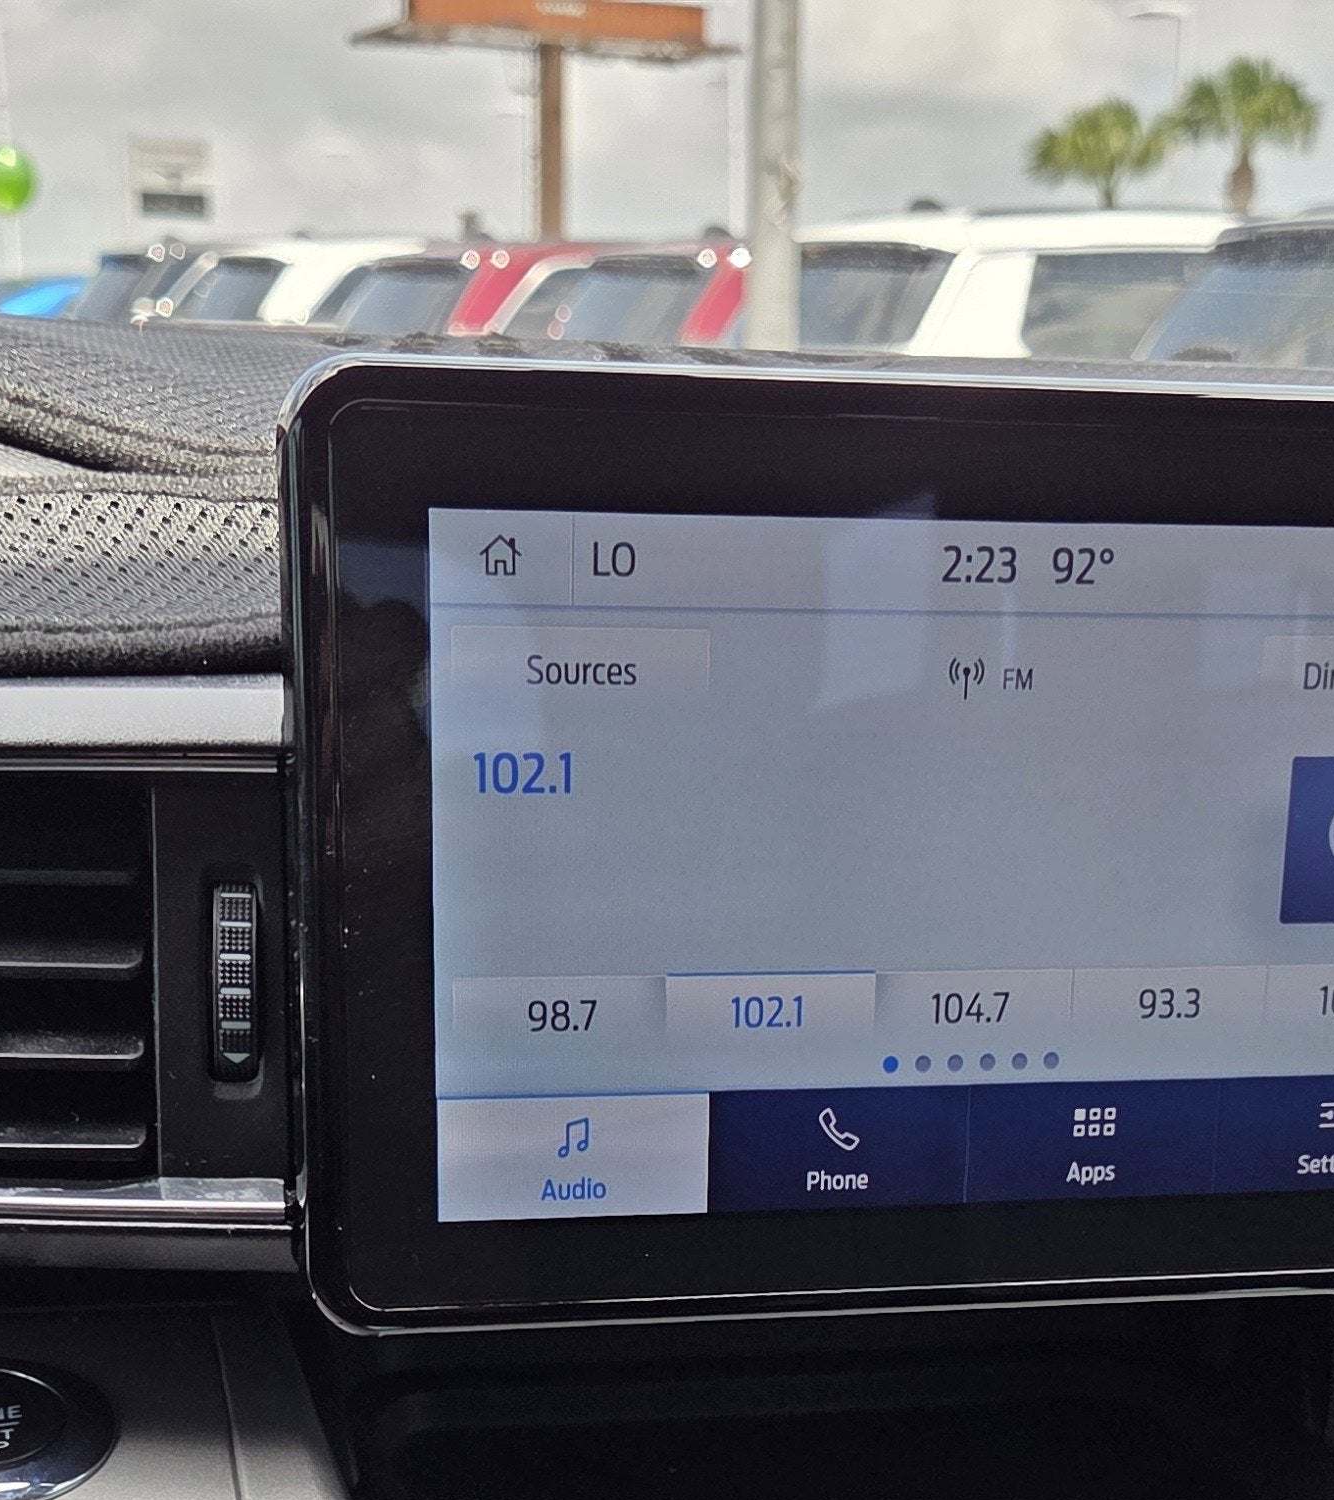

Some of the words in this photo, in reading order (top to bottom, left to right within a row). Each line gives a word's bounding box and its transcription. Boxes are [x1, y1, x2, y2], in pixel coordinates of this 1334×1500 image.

[591, 540, 637, 578] LO
[941, 544, 1018, 585] 2:23
[1051, 547, 1115, 586] 92°
[525, 654, 638, 687] Sources
[1001, 668, 1034, 691] FM
[472, 751, 573, 795] 102.1
[527, 999, 598, 1033] 98.7
[730, 994, 805, 1030] 102.1
[931, 991, 1011, 1026] 104.7
[1137, 987, 1202, 1020] 93.3
[540, 1177, 607, 1202] Audio
[806, 1170, 869, 1192] Phone
[1065, 1160, 1116, 1186] Apps
